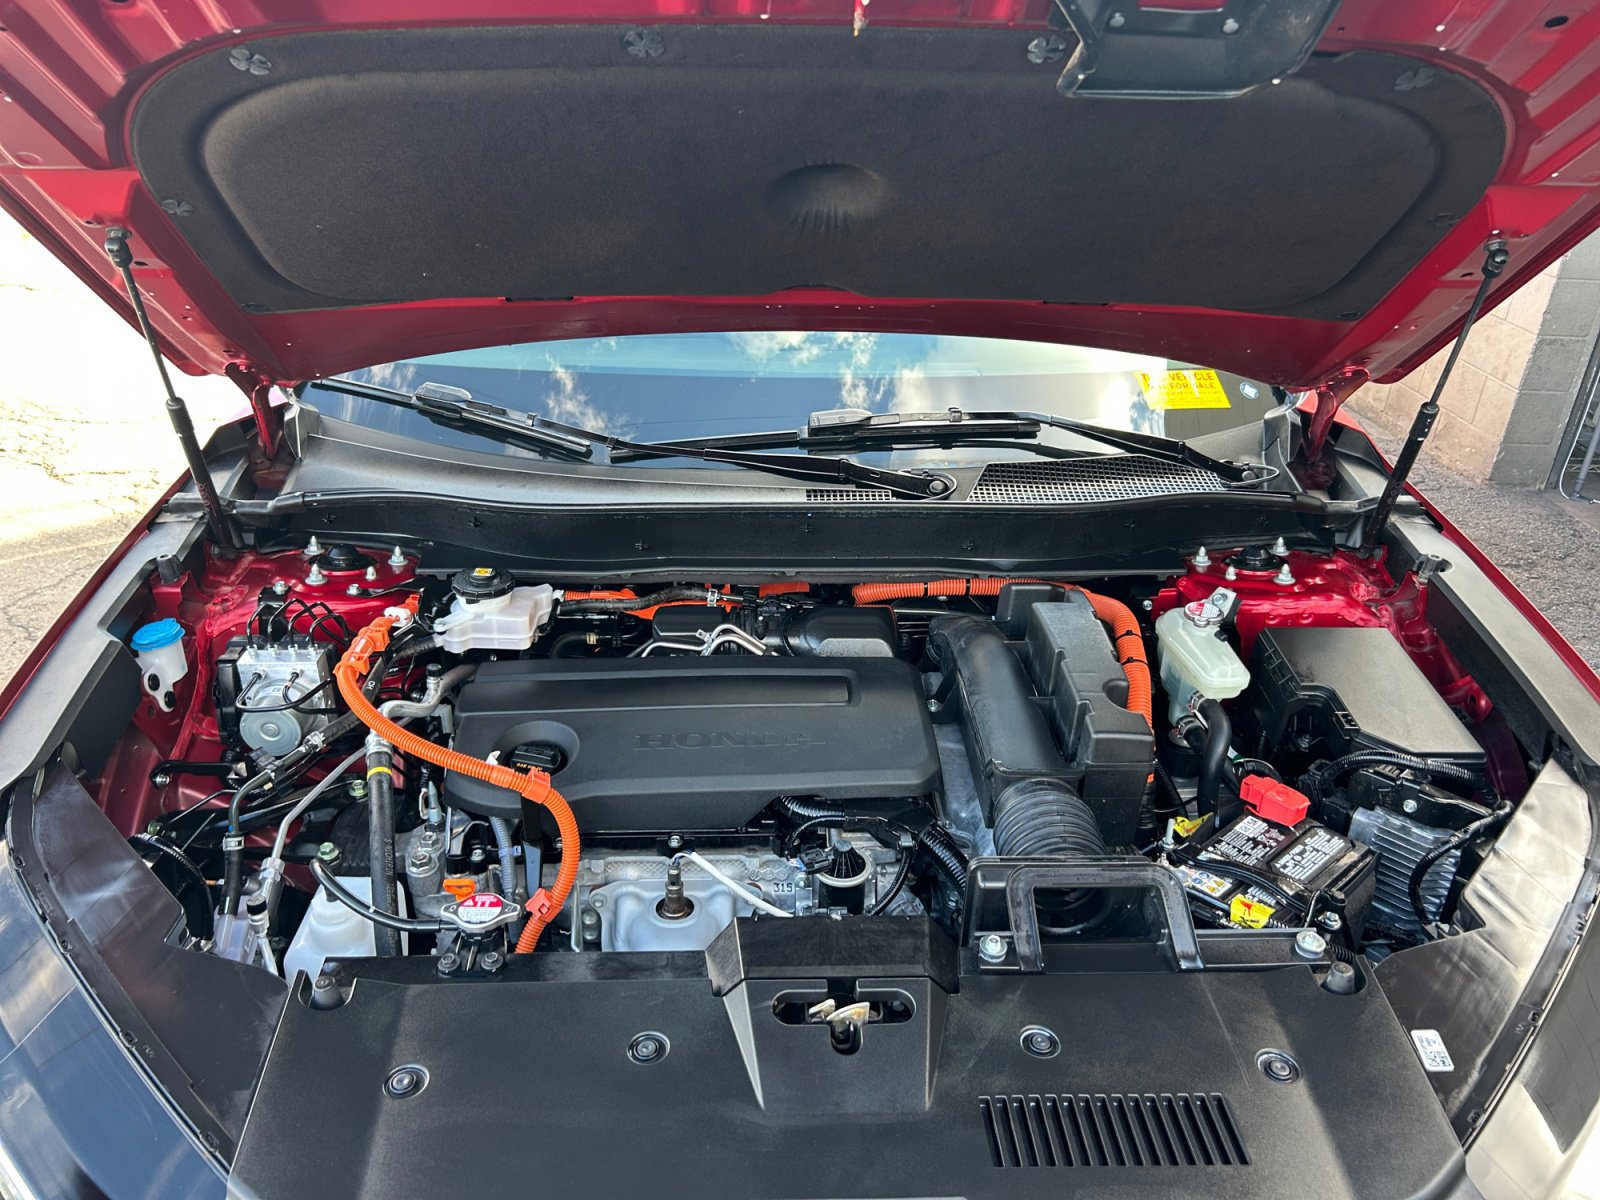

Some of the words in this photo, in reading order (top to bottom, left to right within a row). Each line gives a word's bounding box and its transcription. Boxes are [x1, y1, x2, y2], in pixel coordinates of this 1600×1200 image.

[1168, 372, 1214, 381] VECLE
[633, 731, 826, 751] HONDA
[773, 882, 793, 893] 315
